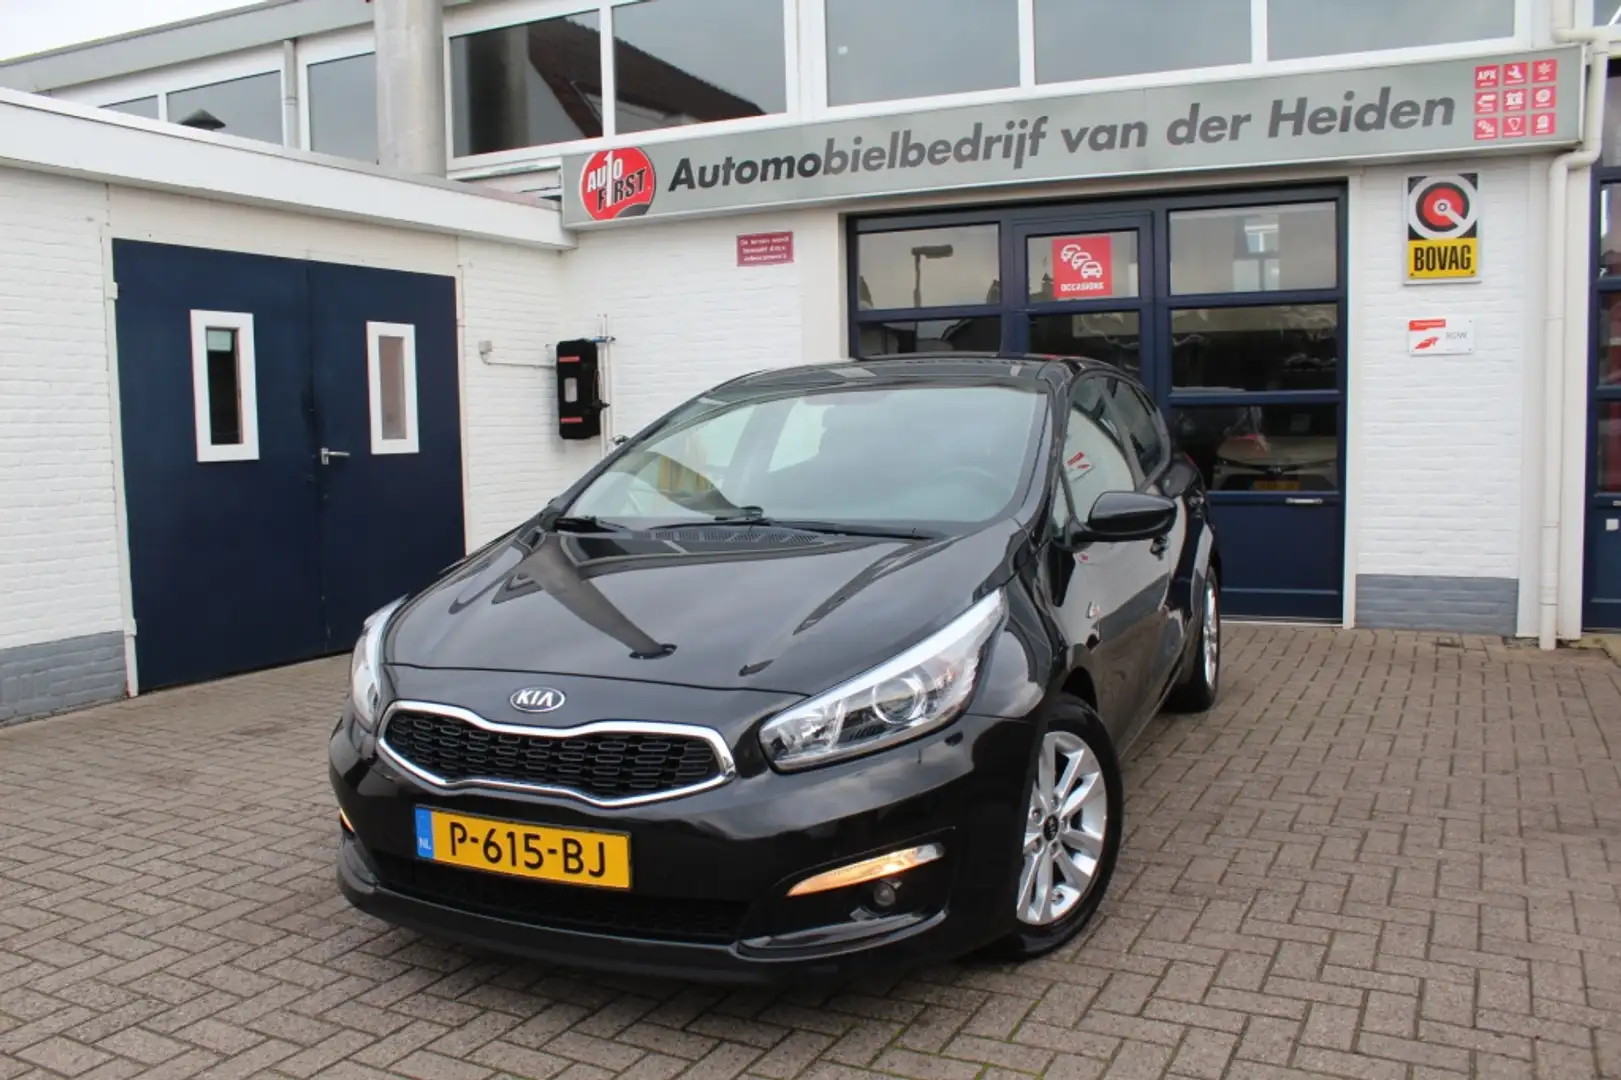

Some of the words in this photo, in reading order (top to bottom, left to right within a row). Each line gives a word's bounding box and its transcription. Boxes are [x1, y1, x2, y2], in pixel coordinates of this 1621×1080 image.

[668, 115, 1049, 192] Automobielbedrijf
[1061, 121, 1149, 154] van
[1166, 102, 1252, 146] der
[1267, 86, 1455, 139] Heiden
[597, 167, 646, 212] FIRST
[1413, 244, 1471, 272] BOVAG
[1061, 281, 1105, 292] OCCASIONS
[516, 689, 553, 707] KIA
[419, 837, 431, 850] NL
[450, 821, 606, 878] P-615-BJ
